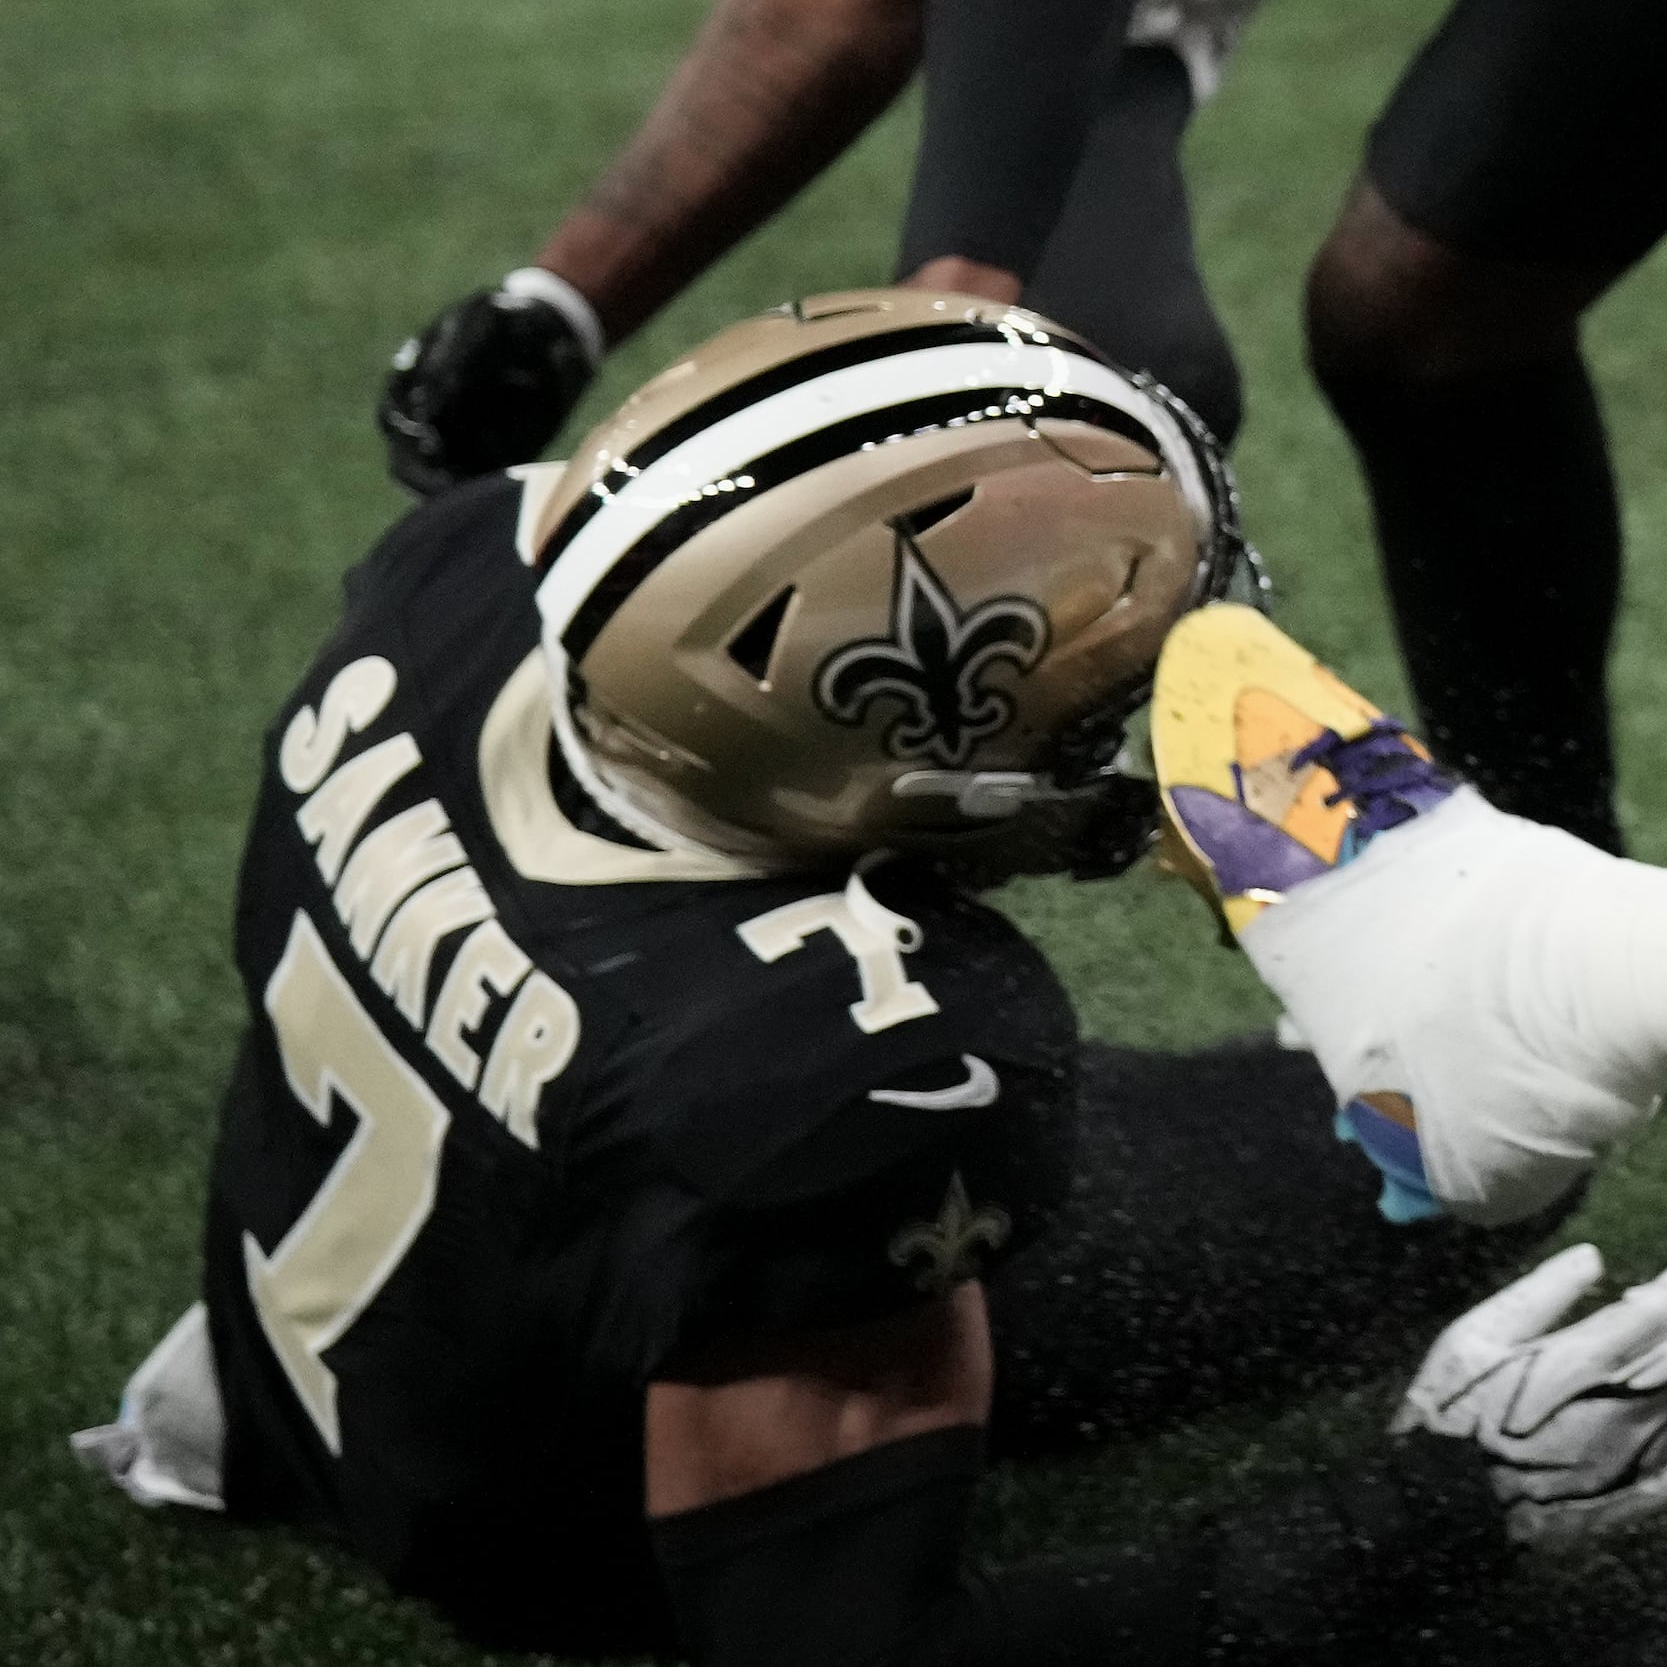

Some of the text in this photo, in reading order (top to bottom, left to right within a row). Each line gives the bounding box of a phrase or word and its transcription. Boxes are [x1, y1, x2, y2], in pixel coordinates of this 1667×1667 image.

[280, 653, 581, 1150] SANKER
[734, 873, 941, 1035] 7
[242, 908, 452, 1458] 7
